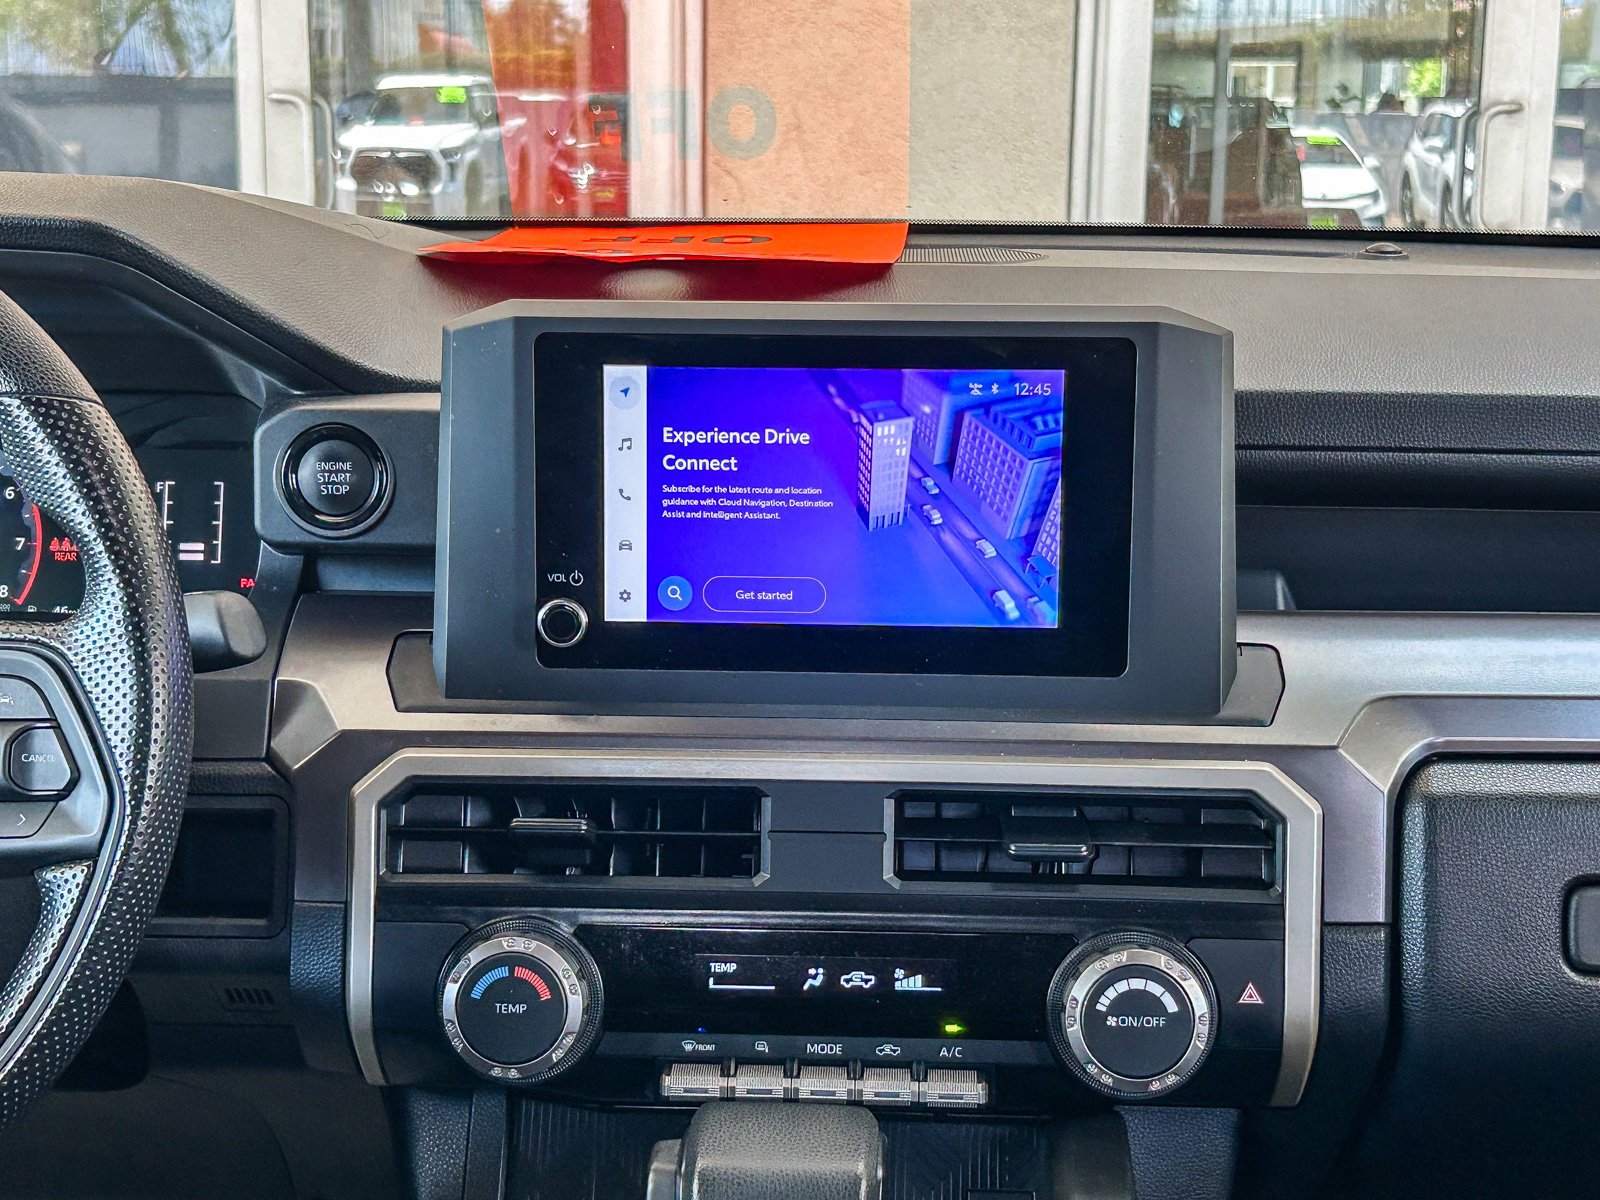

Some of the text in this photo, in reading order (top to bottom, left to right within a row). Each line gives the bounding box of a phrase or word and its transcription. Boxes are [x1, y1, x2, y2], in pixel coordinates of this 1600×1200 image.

[1014, 382, 1052, 396] 12:45
[662, 426, 811, 447] Experience Drive
[316, 461, 353, 471] ENGINE
[662, 454, 738, 472] Connect
[317, 472, 352, 483] START
[5, 486, 15, 499] 6
[156, 481, 164, 493] F
[320, 484, 350, 495] STOP
[662, 484, 823, 495] Subscribe for the latest route and location
[662, 497, 834, 509] guidance with Cloud Navigation, Destination
[662, 510, 781, 520] Assist and Intelligent Assistant.
[14, 537, 26, 551] 7
[54, 551, 77, 561] REAR
[547, 572, 567, 583] VOL
[0, 584, 9, 598] 8
[735, 589, 793, 600] Get started
[21, 753, 56, 763] CANCEL
[709, 962, 737, 973] TEMP
[495, 1003, 527, 1014] TEMP
[1118, 1015, 1166, 1027] ON/OFF
[695, 1043, 716, 1052] FRONT
[806, 1042, 843, 1055] MODE
[939, 1046, 963, 1058] A/C
